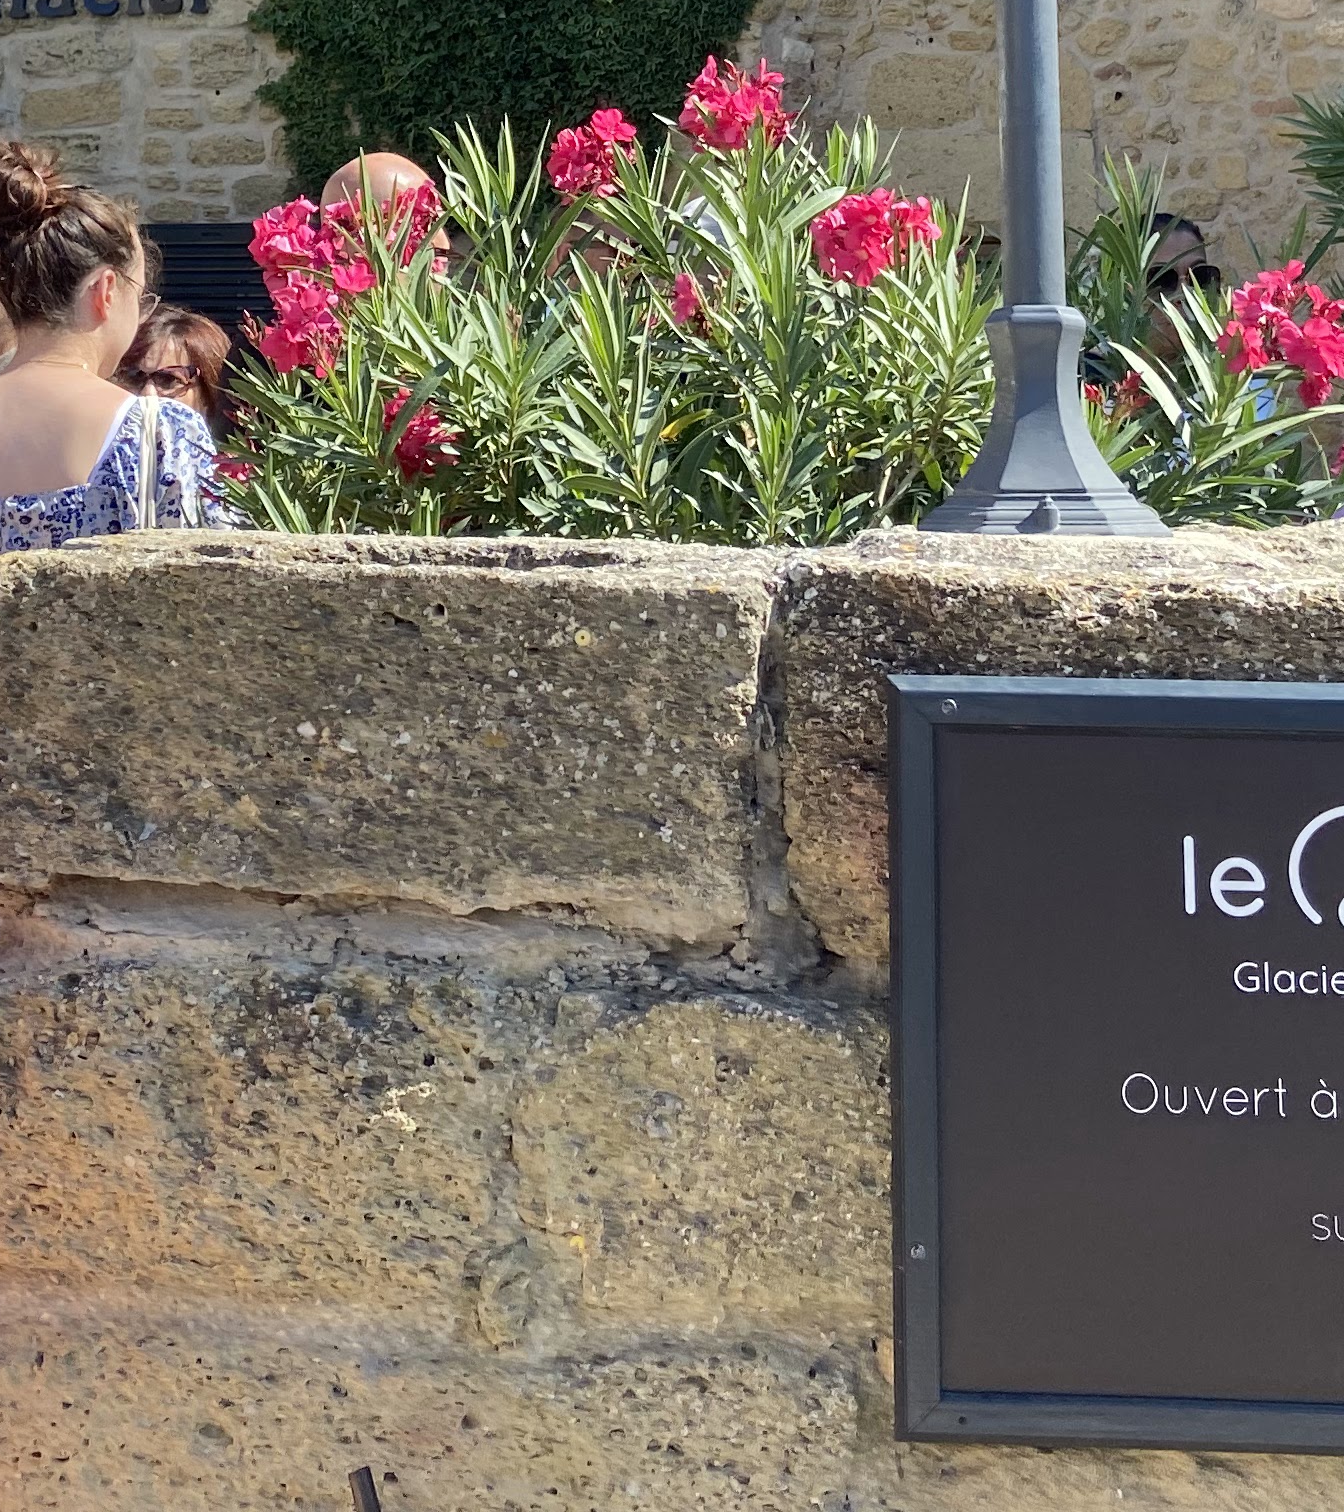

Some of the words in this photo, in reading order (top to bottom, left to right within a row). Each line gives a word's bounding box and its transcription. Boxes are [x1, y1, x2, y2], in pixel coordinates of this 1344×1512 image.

[1182, 834, 1267, 919] le
[1120, 1071, 1288, 1119] Ouvert
[1309, 1077, 1339, 1120] à
